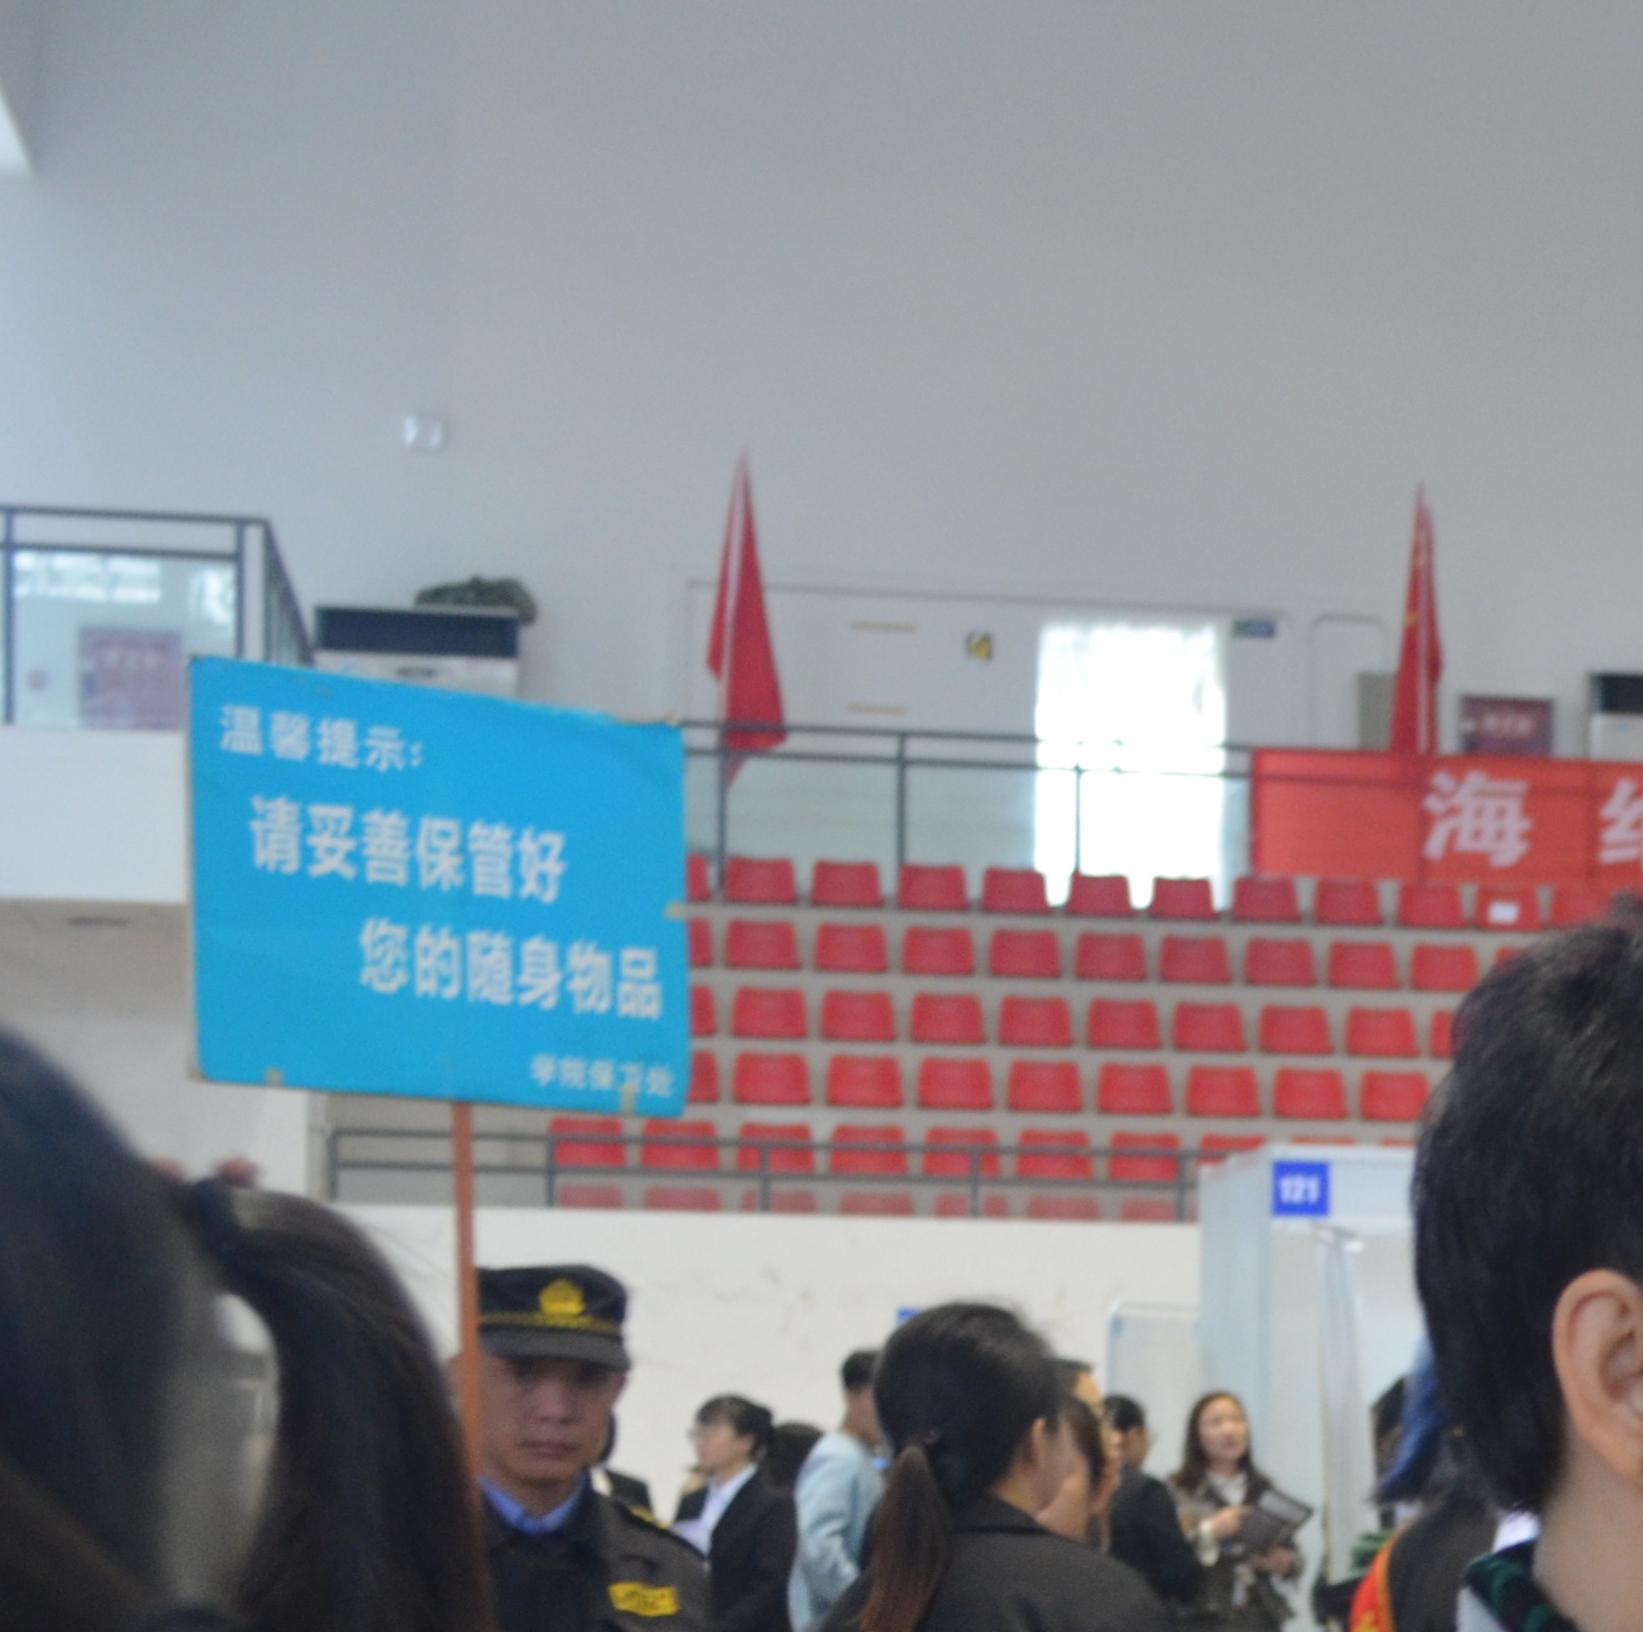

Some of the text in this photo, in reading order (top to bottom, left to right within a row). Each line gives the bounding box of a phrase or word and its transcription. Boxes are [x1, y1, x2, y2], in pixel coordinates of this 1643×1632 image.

[250, 795, 570, 904] 请妥善保管好
[360, 917, 664, 1021] 您的随身物品
